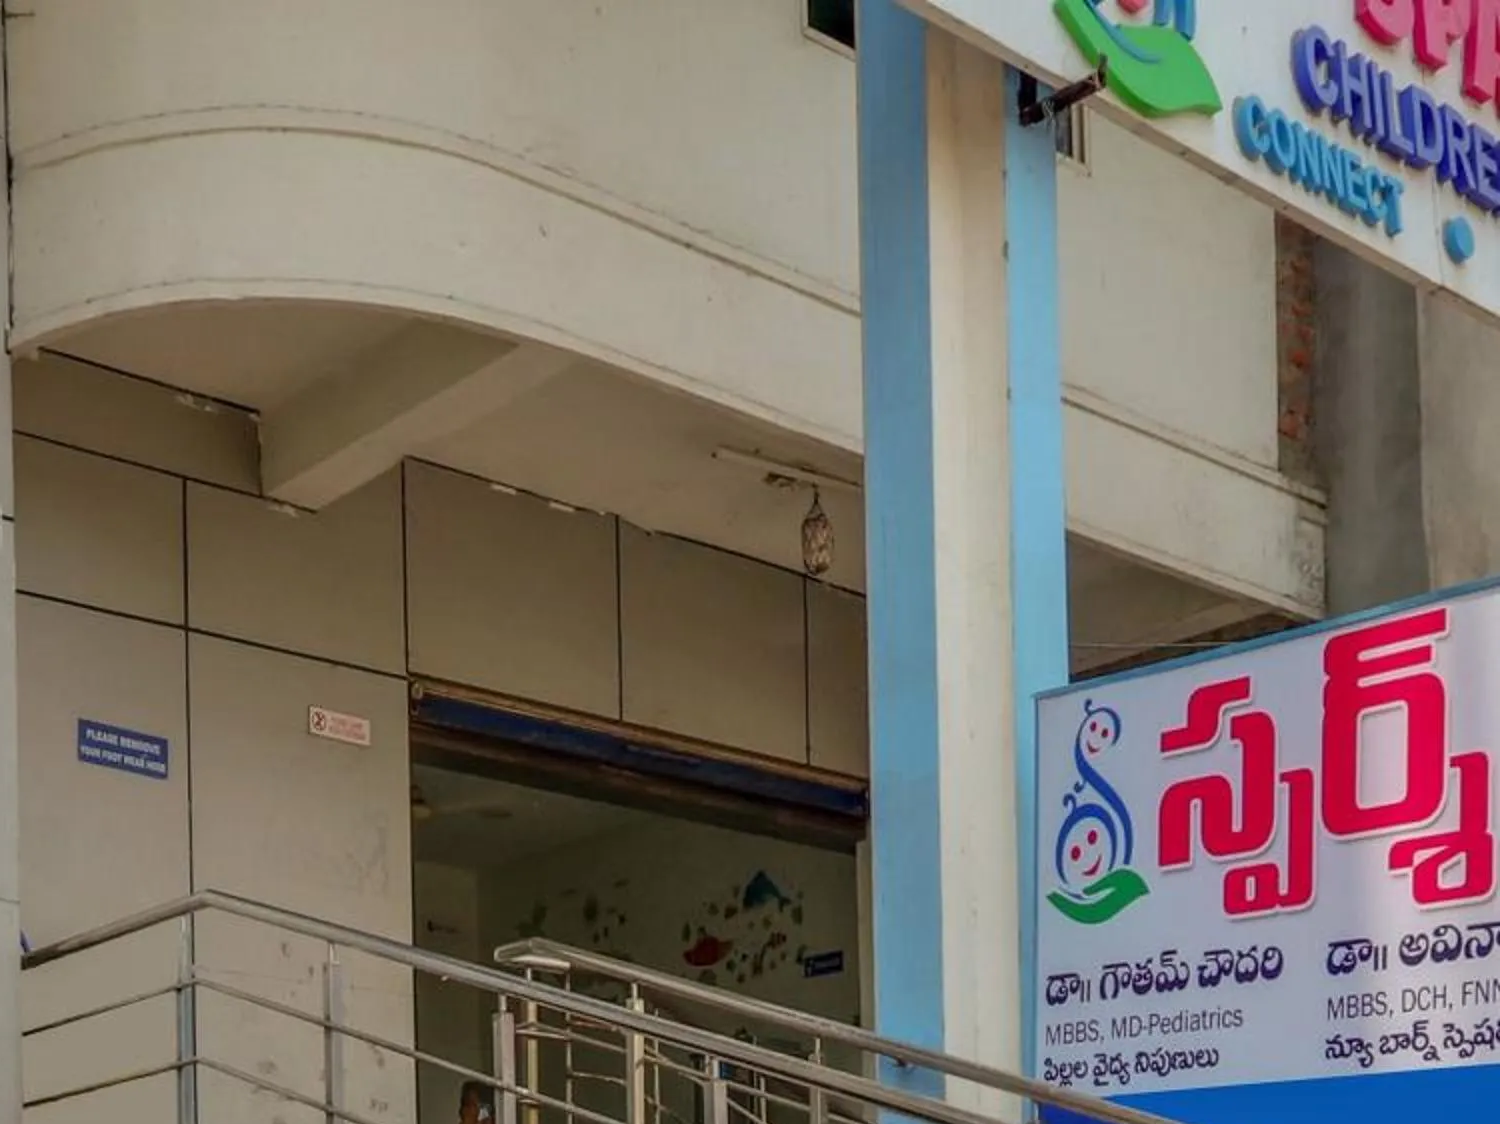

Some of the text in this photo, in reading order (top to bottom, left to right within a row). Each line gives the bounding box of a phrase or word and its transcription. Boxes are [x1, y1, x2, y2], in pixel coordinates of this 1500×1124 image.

[1290, 24, 1500, 218] CHILDRE
[1233, 95, 1403, 238] CONNECT
[1399, 923, 1500, 966] అవినా
[1100, 949, 1190, 1001] గౌతమ్
[1198, 945, 1284, 988] చౌదరి
[1327, 991, 1394, 1021] MBBS,
[1401, 984, 1453, 1013] DCH,
[1045, 1007, 1244, 1046] MBBS, MD-Pediatrics
[1443, 1018, 1500, 1059] స్పెష
